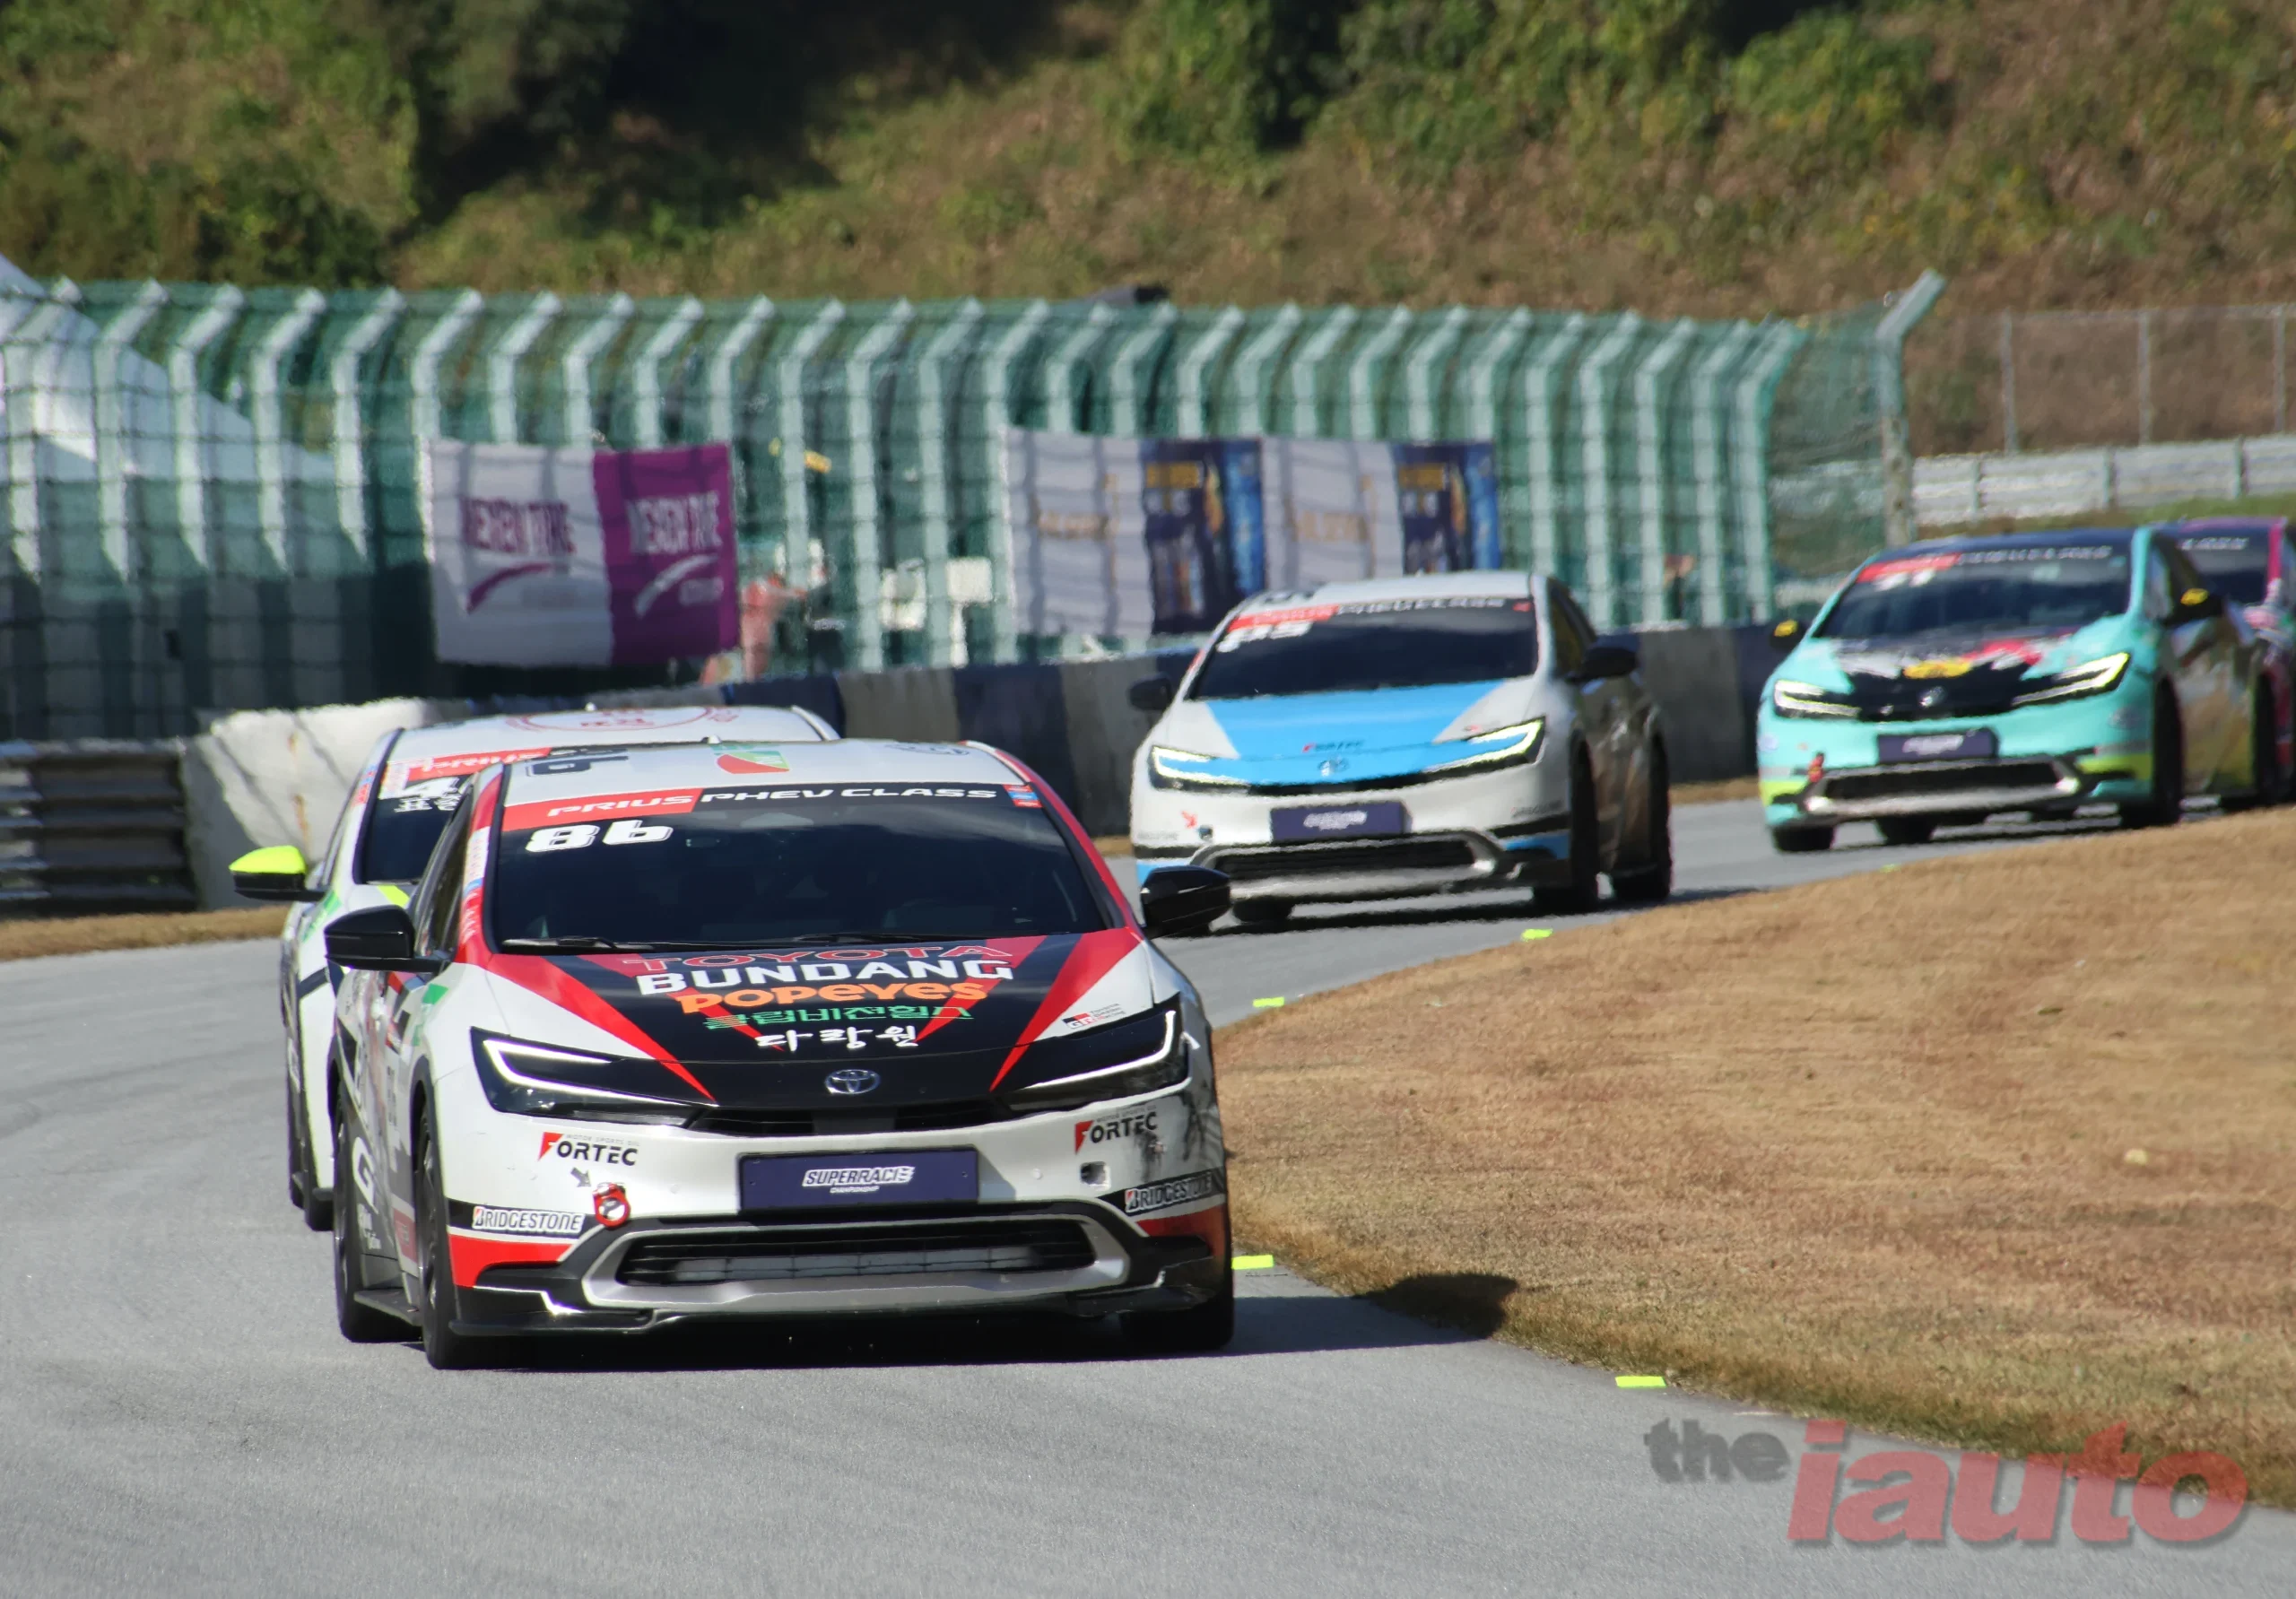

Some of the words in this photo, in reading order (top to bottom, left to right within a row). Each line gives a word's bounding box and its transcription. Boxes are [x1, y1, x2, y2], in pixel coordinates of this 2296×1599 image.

[547, 795, 695, 818] PRIUS
[700, 788, 834, 804] PHEV
[841, 787, 997, 799] CLASS
[526, 819, 674, 853] 86
[623, 945, 1012, 972] TOYOTA
[636, 960, 1014, 995] BUNDANG
[538, 1131, 639, 1167] FORTEC
[1074, 1111, 1158, 1155] FORTEC
[474, 1207, 583, 1232] BRIDGESTONE
